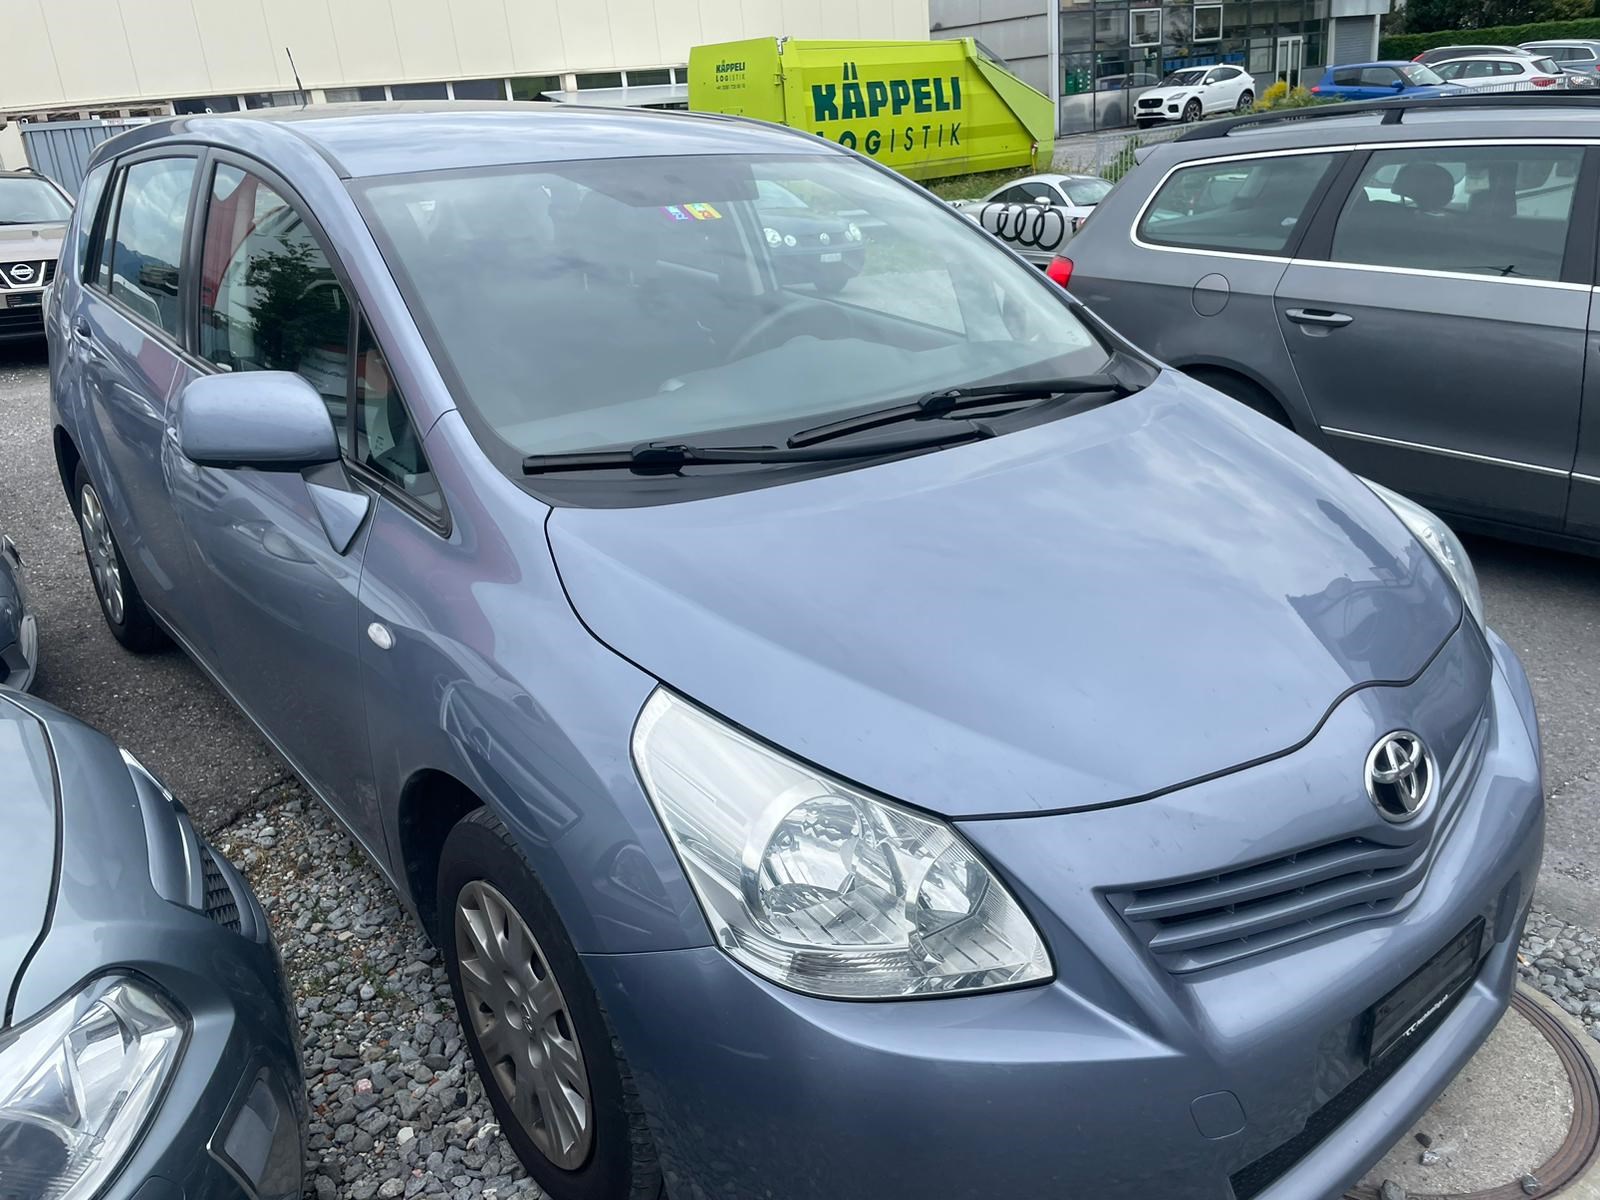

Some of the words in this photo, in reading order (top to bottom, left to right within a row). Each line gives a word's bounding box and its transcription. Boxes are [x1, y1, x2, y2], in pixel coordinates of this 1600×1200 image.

[715, 60, 746, 73] KÄPPELI
[811, 62, 961, 122] KÄPPELI
[816, 123, 961, 155] OGISTIK
